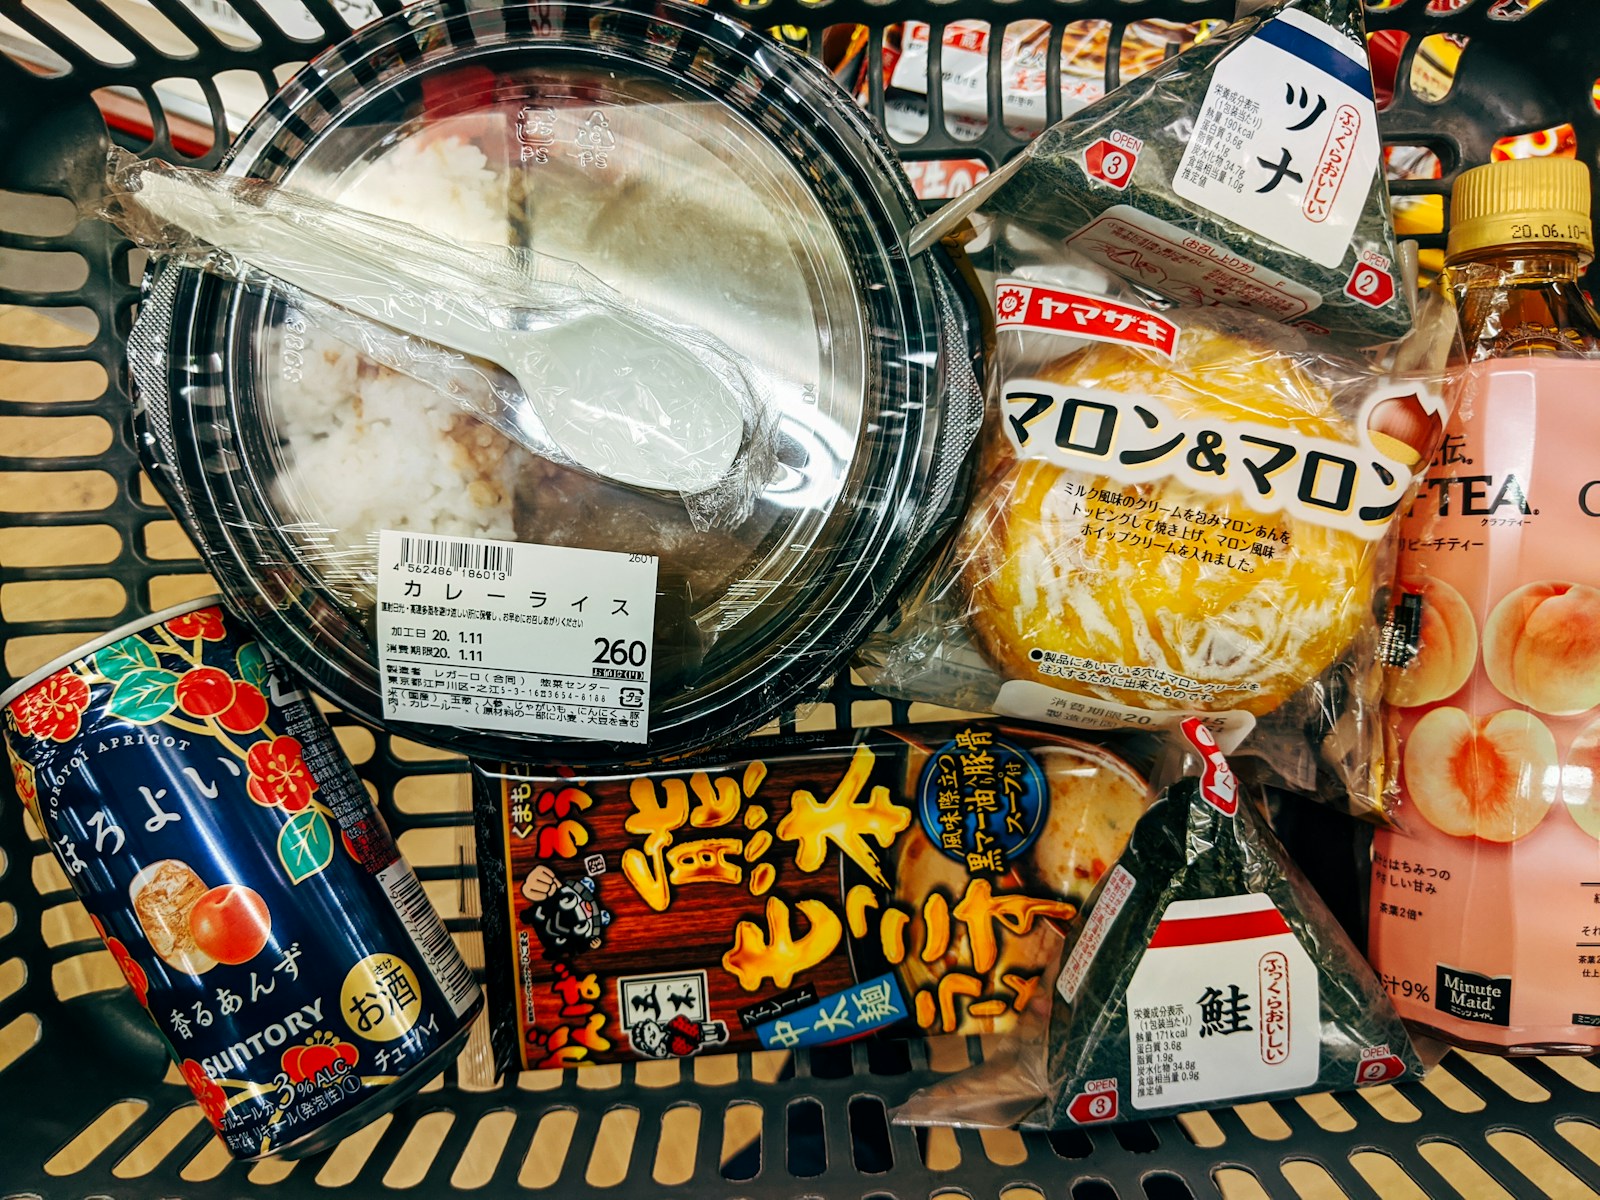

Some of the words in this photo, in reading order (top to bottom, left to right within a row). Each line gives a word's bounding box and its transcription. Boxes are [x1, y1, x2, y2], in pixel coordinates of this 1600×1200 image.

[1214, 83, 1260, 112] 栄養成分表示
[1200, 118, 1223, 141] 蛋白質
[1227, 129, 1243, 150] 3.6g
[1206, 107, 1221, 124] 熱量
[1224, 117, 1254, 140] 190kcal
[1255, 82, 1327, 193] ツナ
[520, 145, 549, 164] PS
[1112, 131, 1142, 152] OPEN
[1195, 130, 1210, 147] 脂質
[1214, 138, 1229, 158] 4.1g
[579, 151, 607, 168] PS
[1109, 155, 1122, 175] 3
[1188, 155, 1226, 184] 食塩相当量
[1227, 175, 1244, 193] 1.0g
[1190, 142, 1223, 167] 炭水化物
[1224, 160, 1246, 180] 34.7g
[1307, 111, 1354, 214] ふっくらおいしい
[1181, 169, 1206, 189] 推定値
[1363, 251, 1389, 270] OPEN
[1359, 274, 1374, 292] 2
[1037, 296, 1168, 345] ヤマザキ
[1005, 392, 1400, 522] マロン&マロン
[1064, 481, 1291, 545] ミルク風味のクリームを包みマロンあんを
[1481, 518, 1532, 527] クラフティー
[1072, 502, 1275, 559] トッピングして焼き上げ、マロン風味
[629, 553, 654, 565] 2601
[1081, 524, 1255, 574] ホイップクリームを入れました。
[393, 563, 399, 571] 4
[408, 564, 452, 576] 562486
[462, 568, 506, 581] 186013
[391, 626, 426, 639] 加工日
[592, 637, 647, 667] 260
[386, 664, 421, 676] 製造者
[540, 679, 610, 691] 惣菜センター
[50, 750, 91, 820] HOROYOI
[98, 735, 191, 754] APRICOT
[937, 753, 964, 850] 風味際立つ
[997, 761, 1027, 835] スープ付
[54, 757, 241, 877] ほろよい
[622, 743, 912, 911] 熊本
[722, 879, 1077, 991] もっこす
[374, 957, 393, 976] さけ
[170, 942, 303, 1040] 香るあんず
[349, 966, 418, 1032] お酒
[1444, 973, 1502, 997] Minute
[743, 991, 813, 1024] ストレート
[770, 978, 893, 1046] 中太麺
[1134, 1004, 1184, 1020] 栄養成分表示
[1195, 984, 1254, 1039] 鮭
[1263, 958, 1284, 1061] ふっくらおいしい
[202, 997, 326, 1079] SUNTORY
[374, 1012, 440, 1073] チューハイ
[1135, 1031, 1153, 1043] 熱量
[1155, 1028, 1188, 1041] 171kcal
[1136, 1042, 1162, 1053] 蛋白質
[1163, 1041, 1182, 1052] 3.6g
[1136, 1053, 1154, 1065] 脂質
[1155, 1052, 1173, 1064] 1.9g
[1362, 1045, 1389, 1058] OPEN
[1137, 1063, 1170, 1076] 炭水化物
[1172, 1060, 1196, 1073] 34.8g
[1138, 1072, 1180, 1086] 食塩相当量
[1181, 1070, 1199, 1083] 0.9g
[1370, 1065, 1380, 1077] 2
[1087, 1079, 1117, 1091] OPEN
[1138, 1085, 1163, 1097] 推定値
[220, 1100, 275, 1132] アルコール分
[1095, 1099, 1105, 1113] 3
